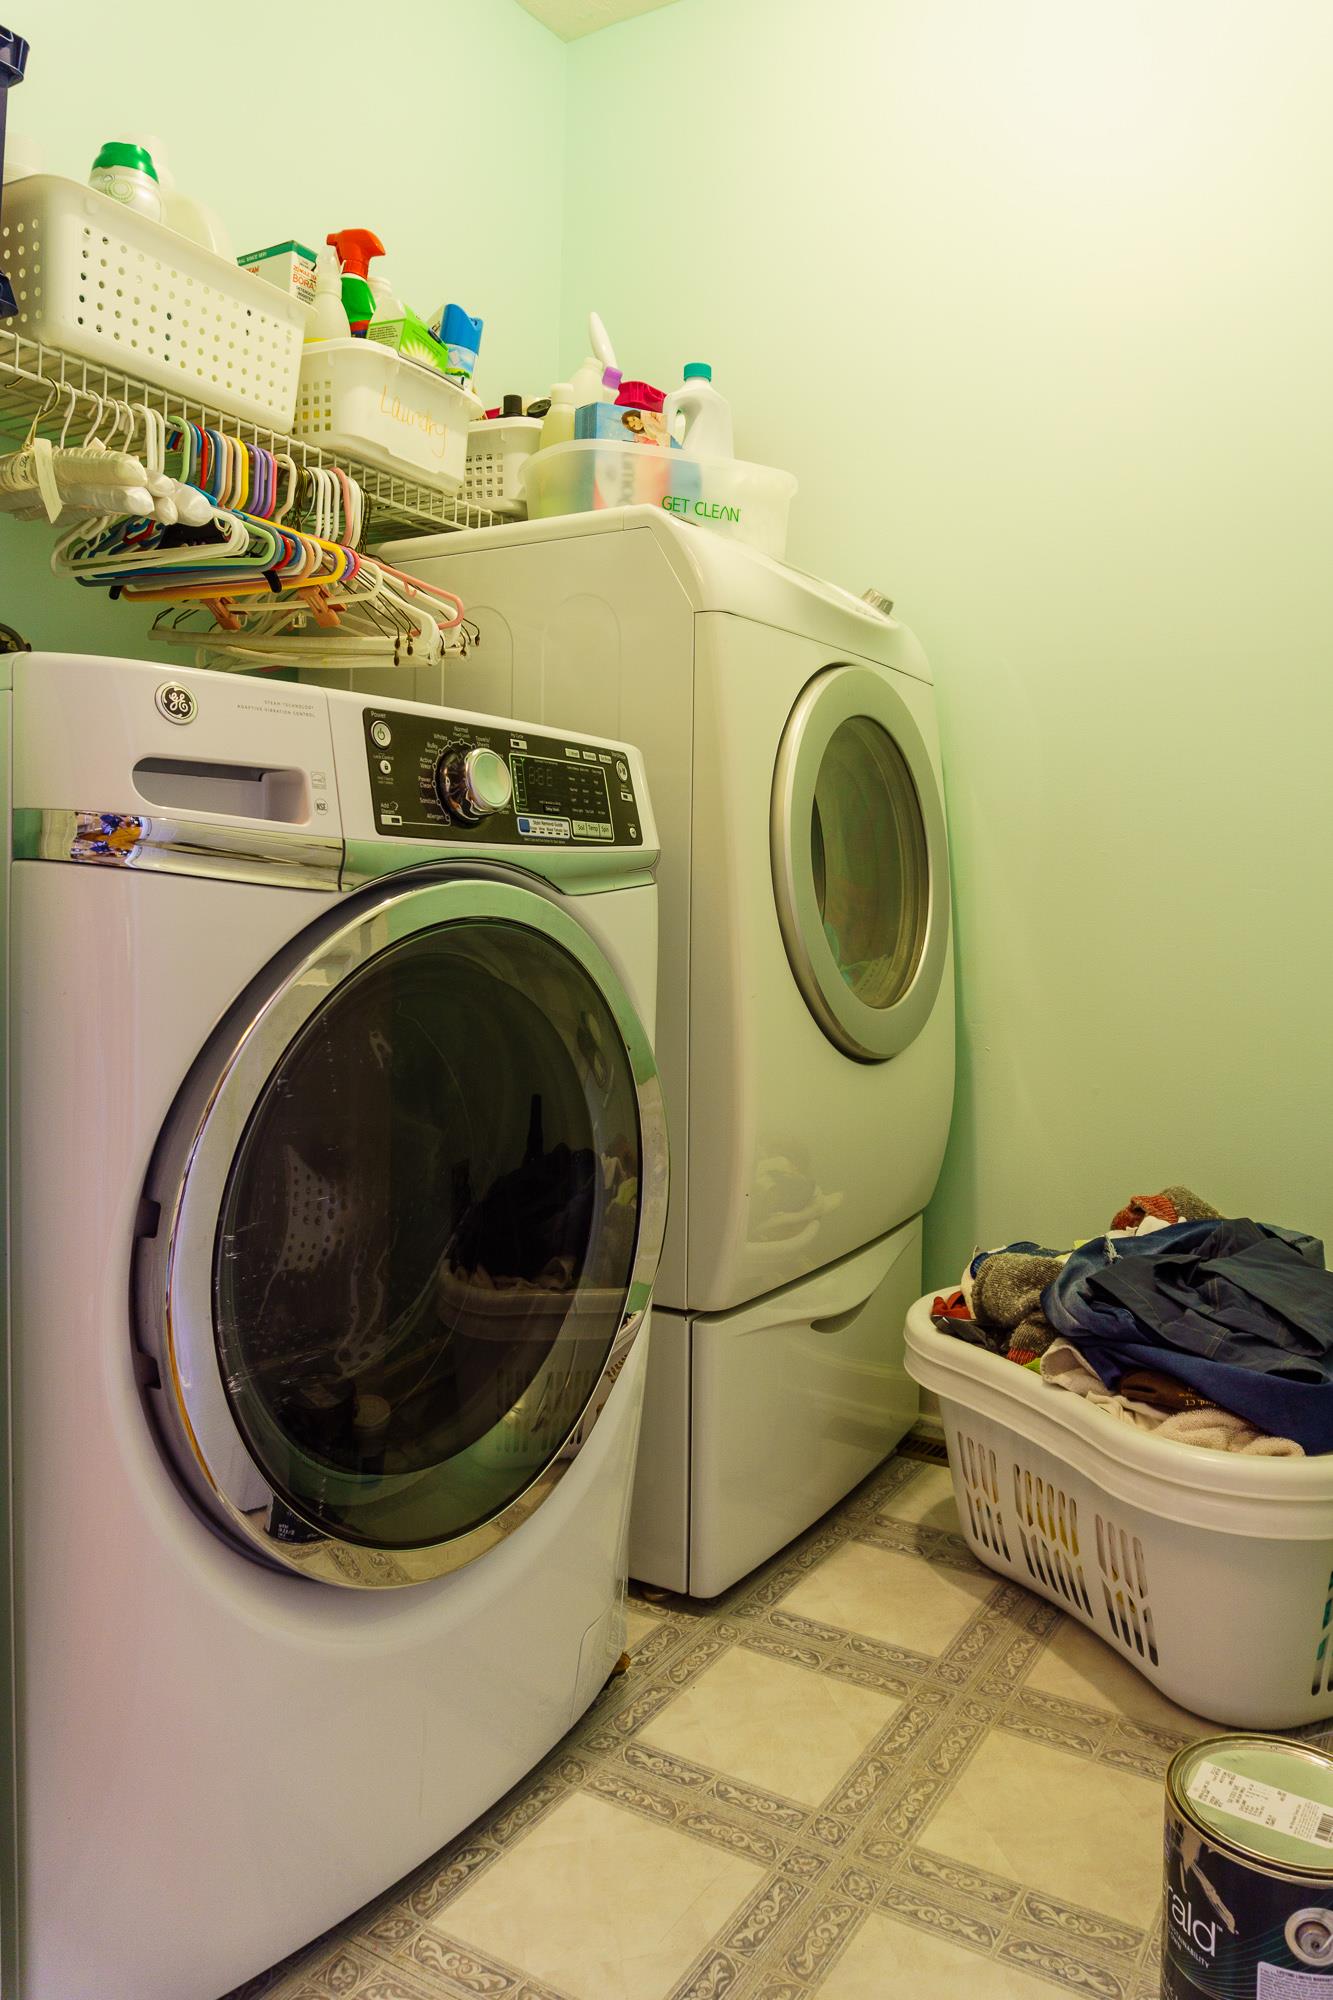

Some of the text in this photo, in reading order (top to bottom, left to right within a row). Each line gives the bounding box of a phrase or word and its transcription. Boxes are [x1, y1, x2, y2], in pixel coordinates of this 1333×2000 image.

[379, 383, 448, 457] Laundry
[662, 495, 740, 522] GET CLEAN
[371, 710, 387, 719] Power
[587, 825, 598, 833] Temp
[601, 826, 609, 834] Spin
